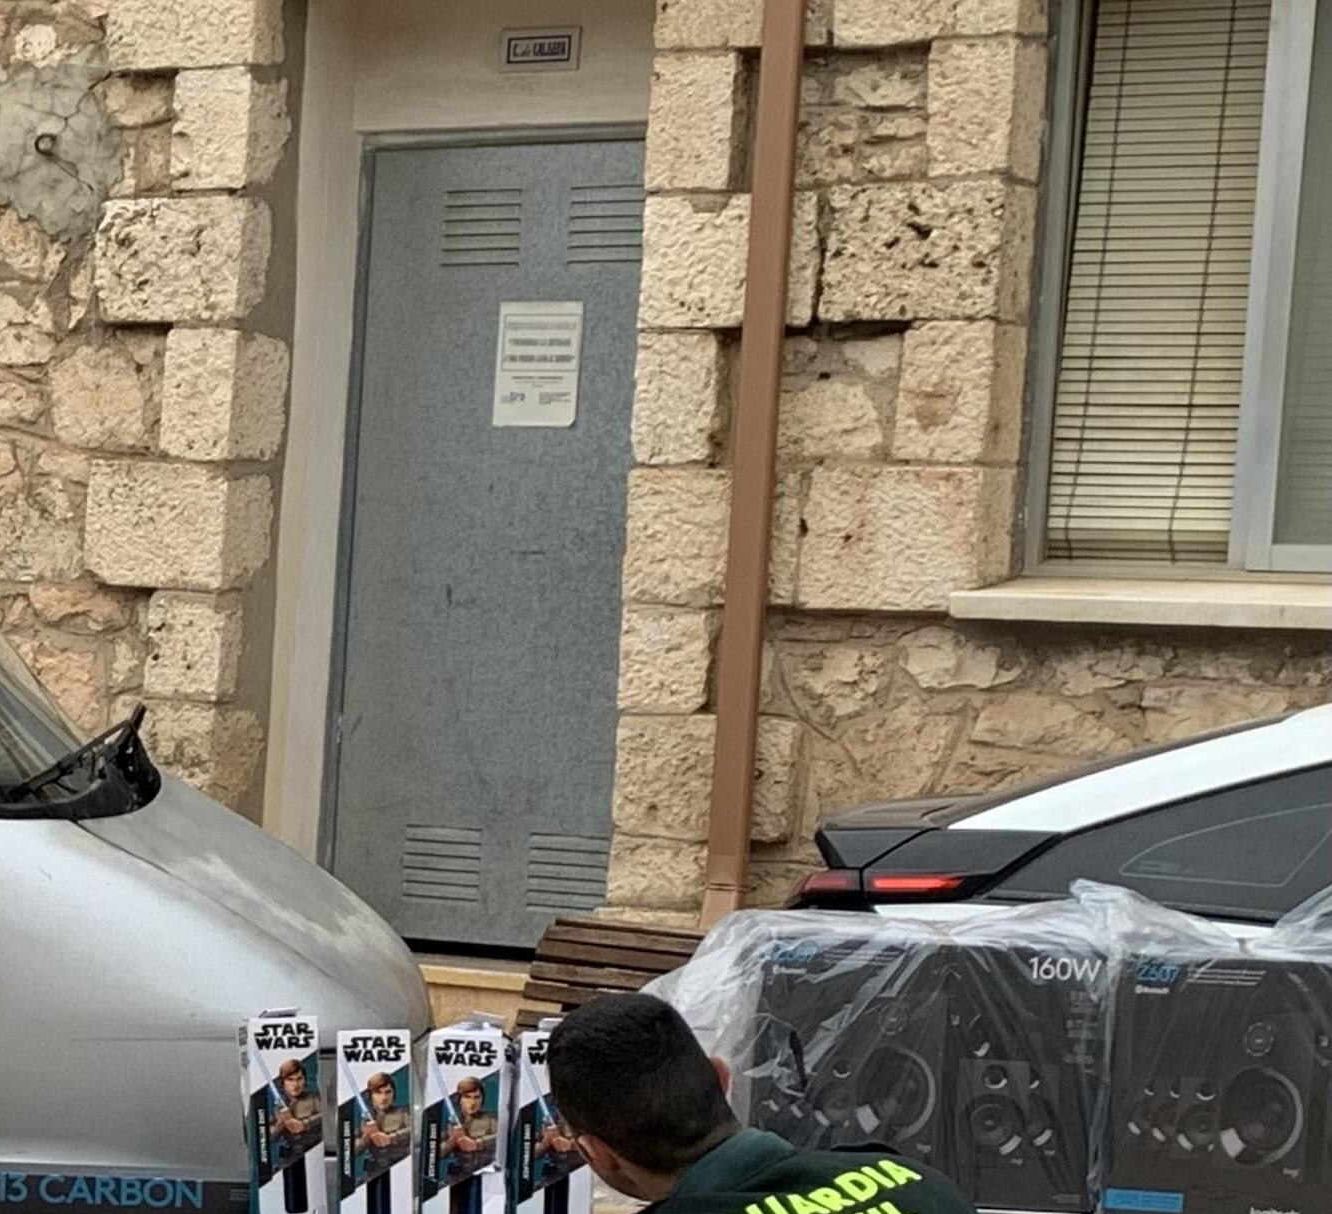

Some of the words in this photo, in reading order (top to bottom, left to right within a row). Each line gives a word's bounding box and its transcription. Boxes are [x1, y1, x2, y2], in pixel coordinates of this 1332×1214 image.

[1028, 957, 1102, 982] 160W
[254, 1023, 314, 1036] STAR
[254, 1035, 314, 1050] WARS
[343, 1036, 405, 1049] STAR
[435, 1039, 497, 1053] STAR
[343, 1049, 405, 1062] WARS
[436, 1052, 497, 1067] WARS
[38, 1176, 204, 1209] CARBON
